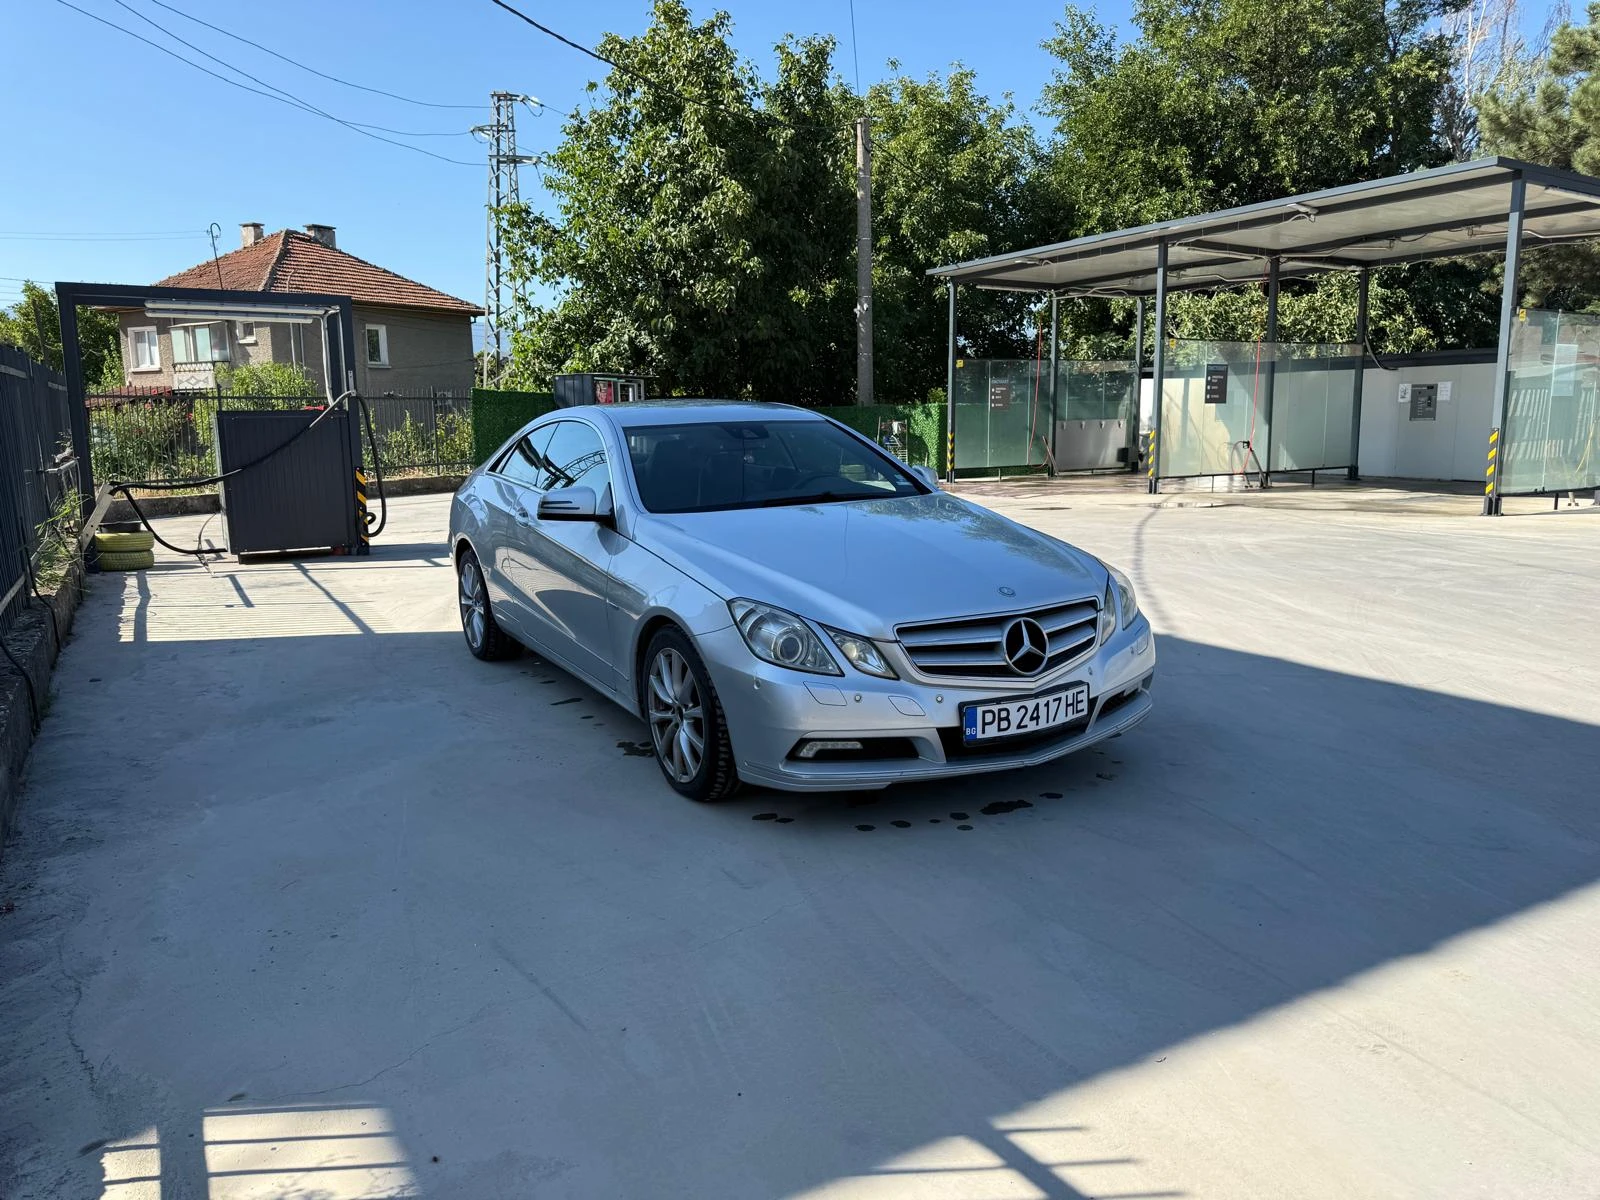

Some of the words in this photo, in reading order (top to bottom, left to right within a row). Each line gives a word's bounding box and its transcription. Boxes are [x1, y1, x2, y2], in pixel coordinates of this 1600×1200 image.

[981, 707, 1011, 734] PB
[1016, 697, 1062, 729] 2417
[1065, 690, 1085, 717] HE
[965, 727, 976, 735] BG
